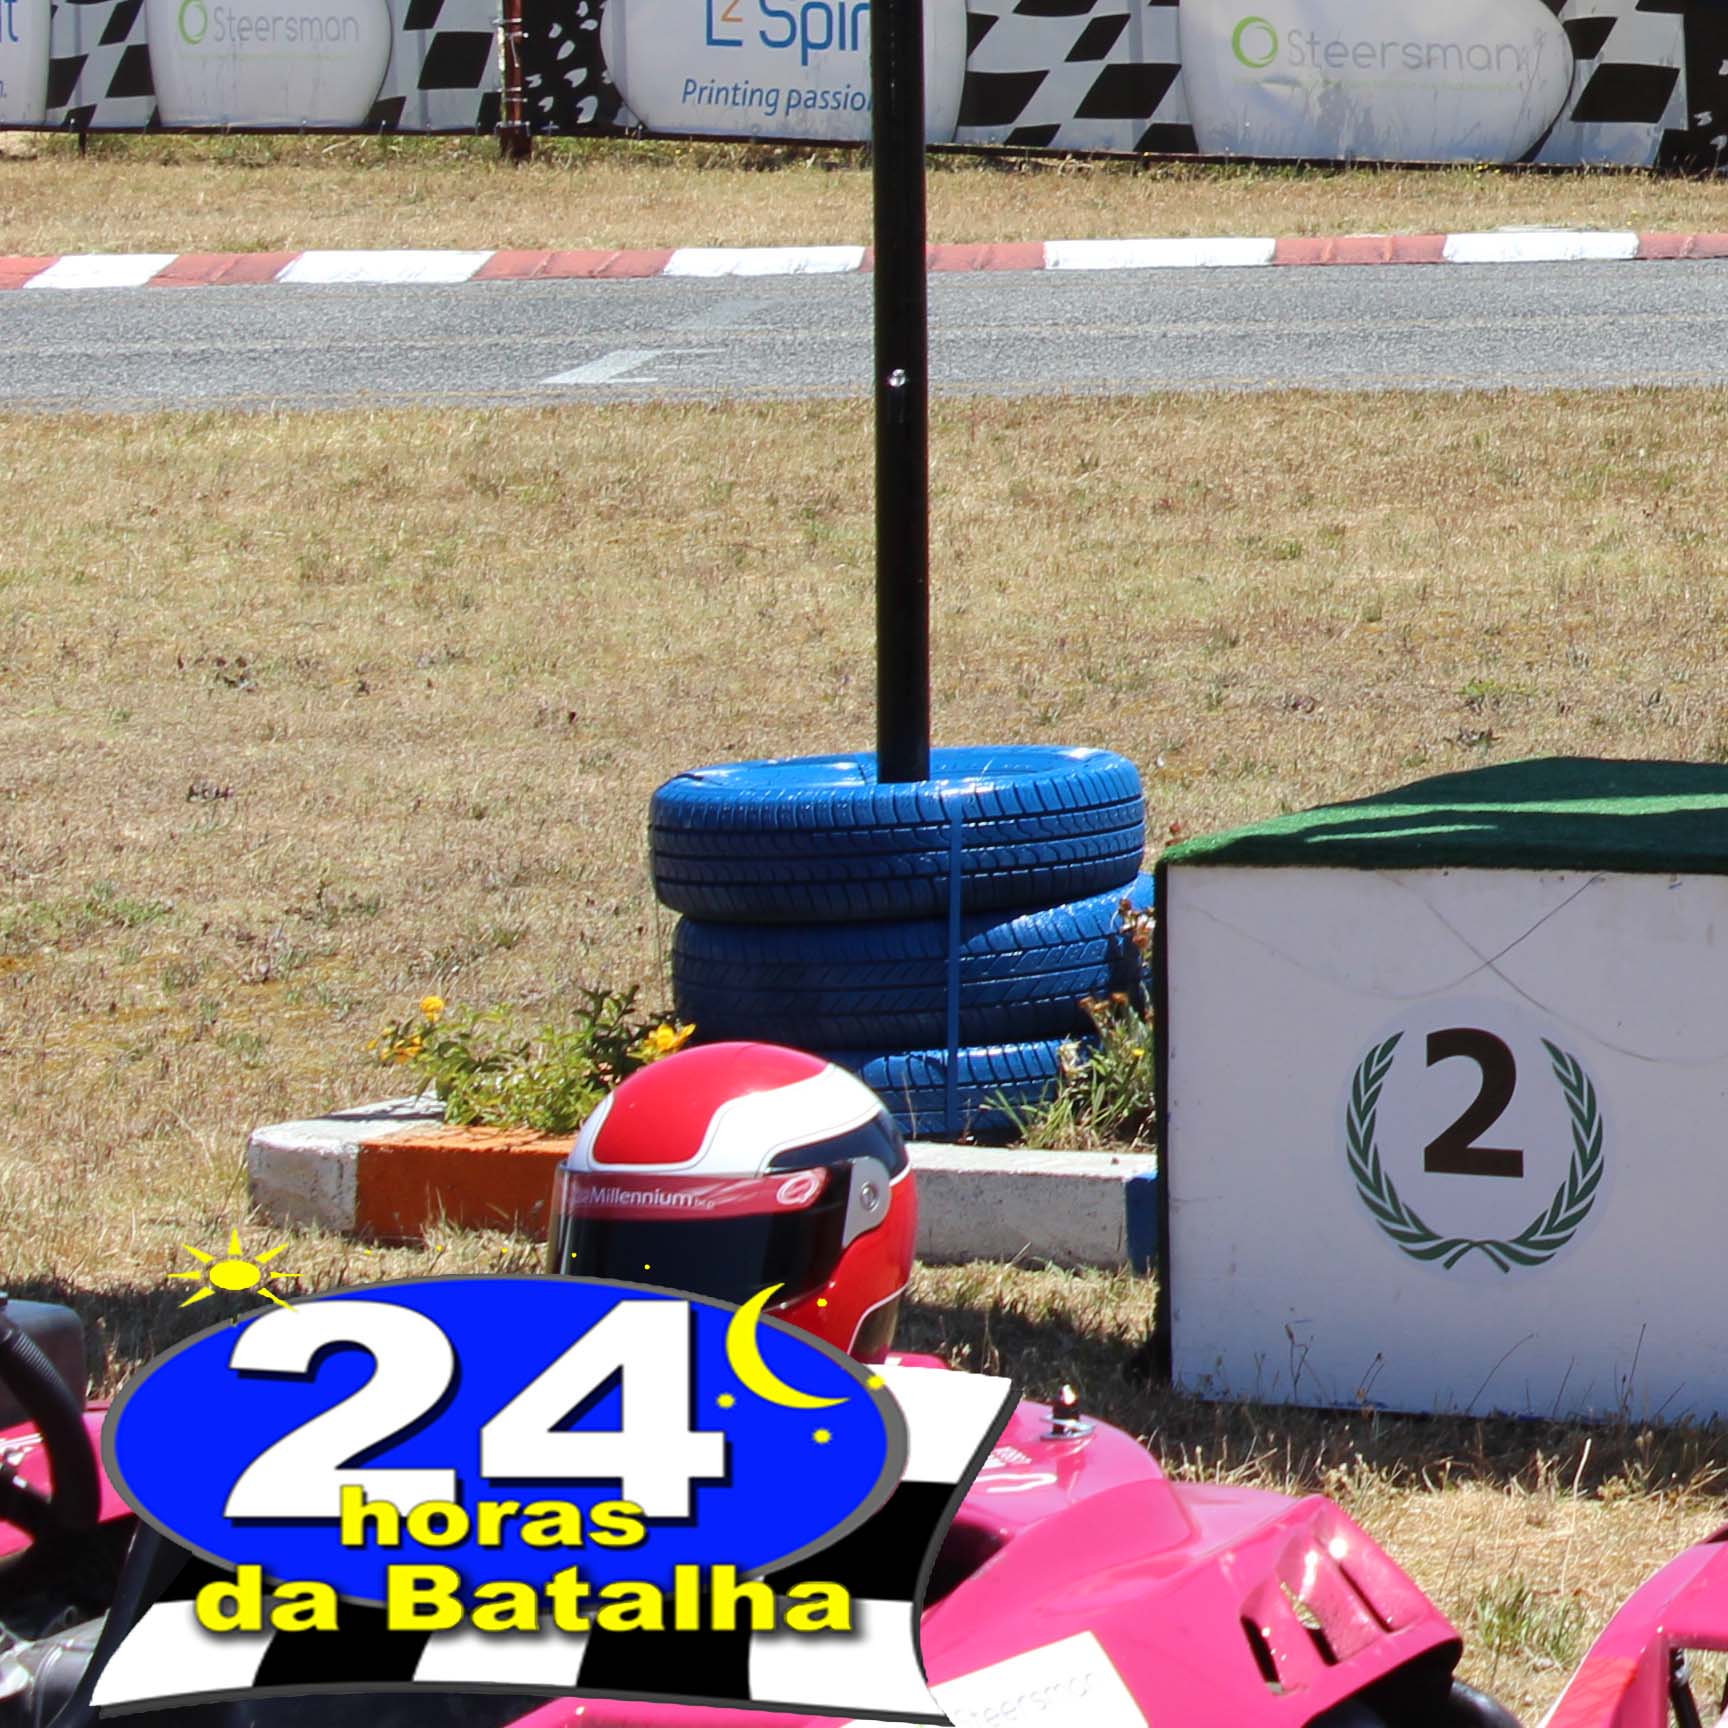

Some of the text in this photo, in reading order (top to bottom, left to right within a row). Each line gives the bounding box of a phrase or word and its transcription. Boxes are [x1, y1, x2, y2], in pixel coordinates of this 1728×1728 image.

[213, 5, 360, 43] Steersman
[1287, 26, 1520, 74] Steersman
[682, 78, 871, 116] Printing passio
[1422, 1027, 1525, 1179] 2
